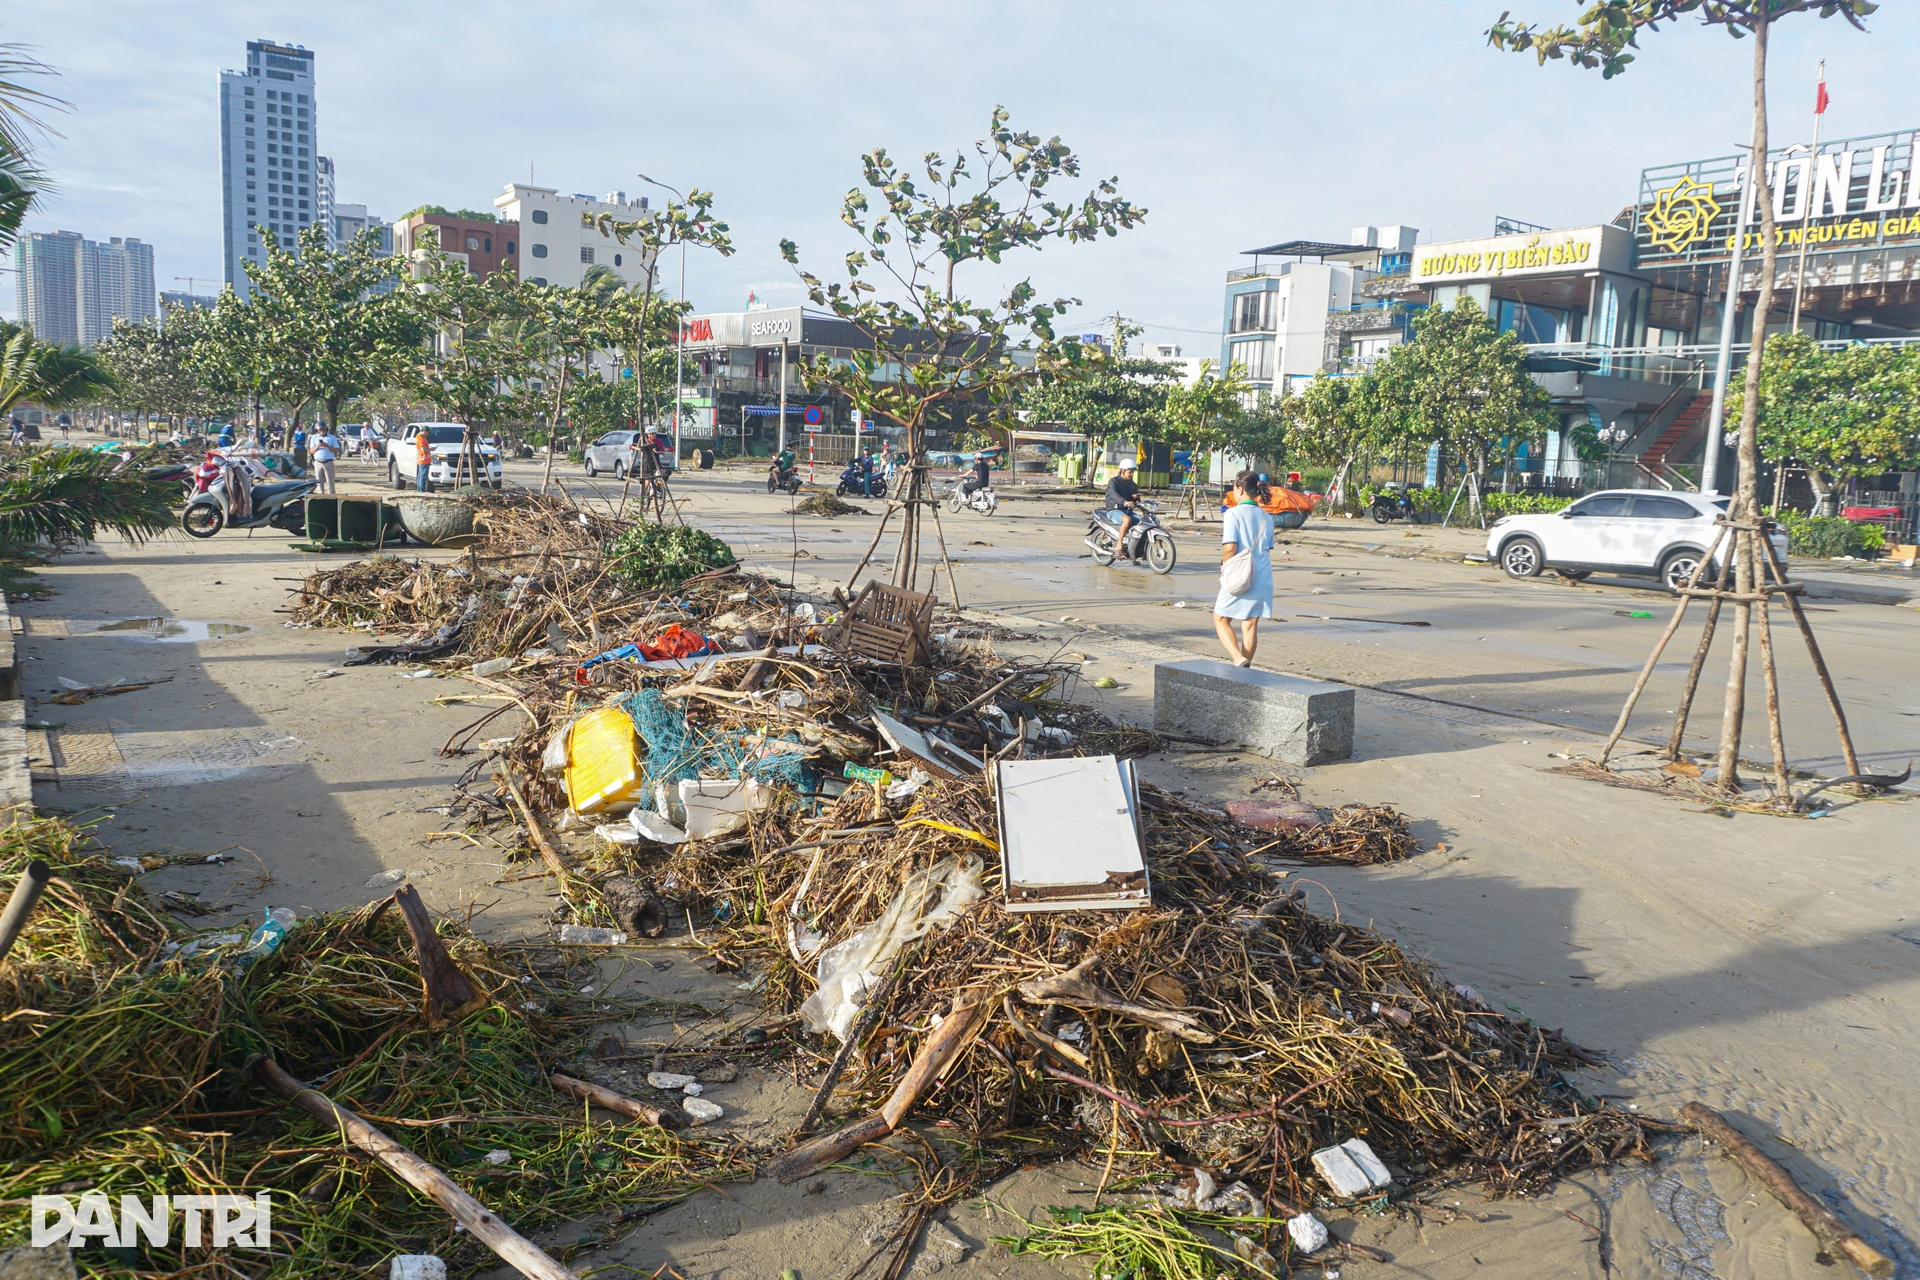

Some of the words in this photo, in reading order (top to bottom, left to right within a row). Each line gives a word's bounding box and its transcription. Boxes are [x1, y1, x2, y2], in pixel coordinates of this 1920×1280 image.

[262, 44, 299, 55] PENINSULA
[1787, 218, 1878, 246] NGUYÊN
[1420, 253, 1481, 276] HƯƠNG
[1484, 251, 1504, 275] VỊ
[1506, 236, 1550, 269] BIỂN
[1552, 237, 1590, 265] SÂU
[751, 318, 792, 336] SEAFOOD
